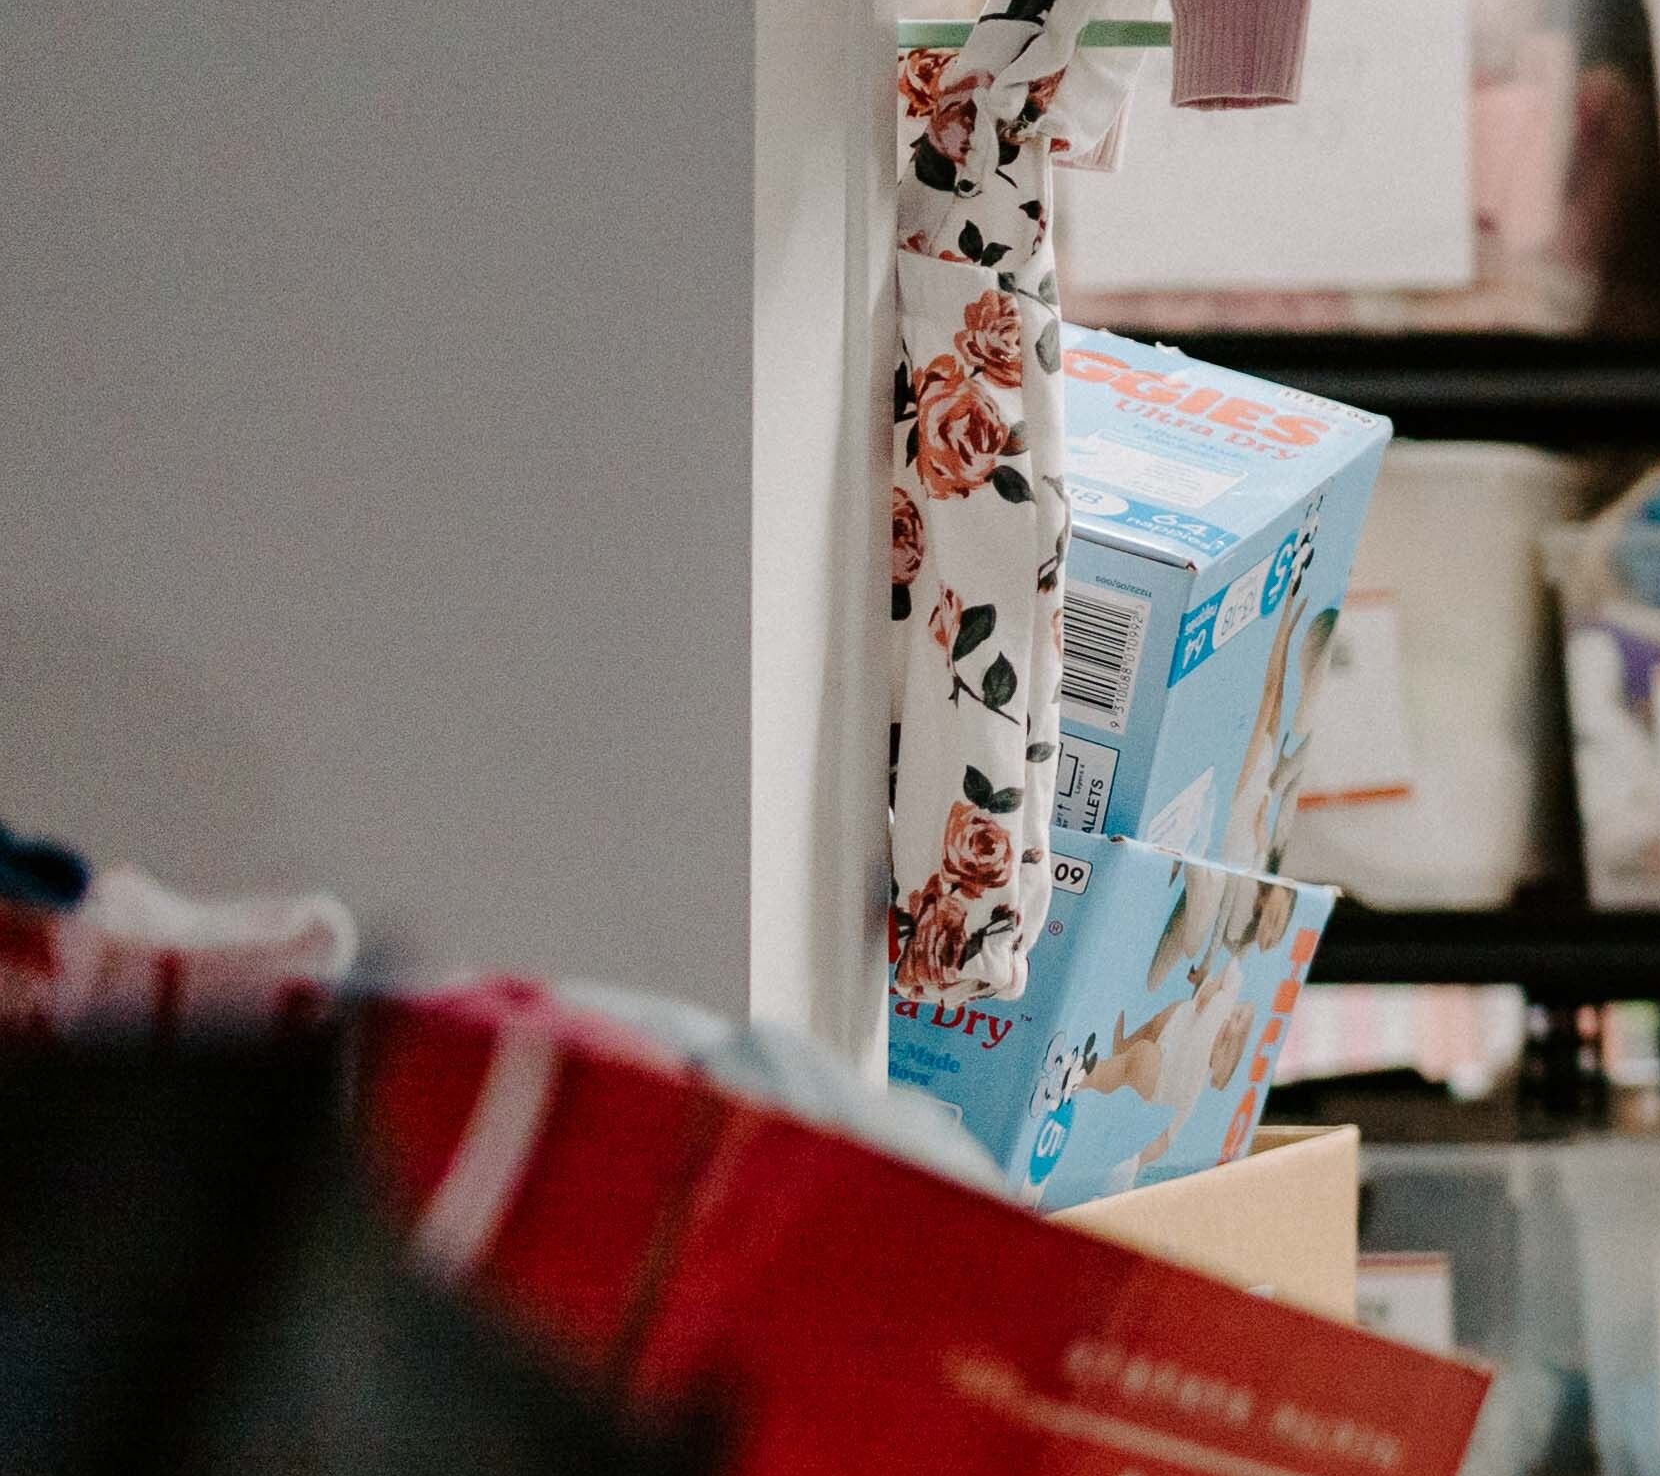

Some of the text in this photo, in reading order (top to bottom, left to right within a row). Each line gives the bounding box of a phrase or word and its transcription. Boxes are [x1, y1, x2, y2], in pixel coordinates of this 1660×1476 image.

[1062, 348, 1329, 447] GGIES
[1115, 398, 1213, 437] Ultra
[1224, 432, 1299, 461] Dry
[1081, 779, 1104, 834] ALLETS
